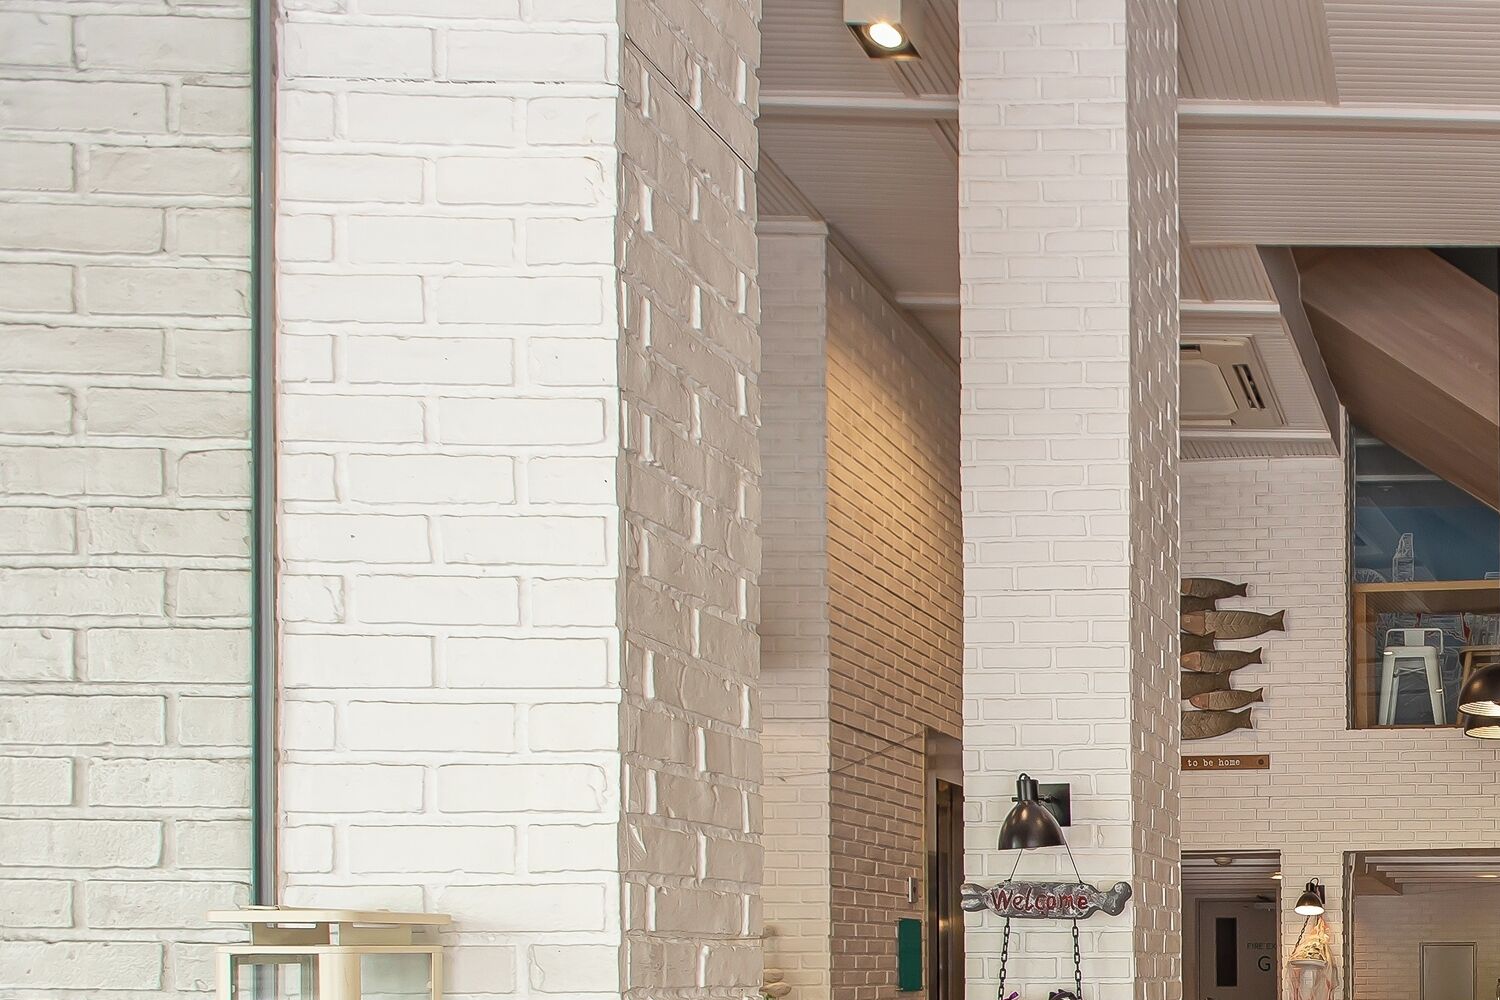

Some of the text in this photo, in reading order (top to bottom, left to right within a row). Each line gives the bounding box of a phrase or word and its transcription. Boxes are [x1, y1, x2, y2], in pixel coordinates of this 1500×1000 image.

[1187, 757, 1241, 767] to be home
[990, 886, 1088, 912] Welcome
[1257, 955, 1272, 972] G
